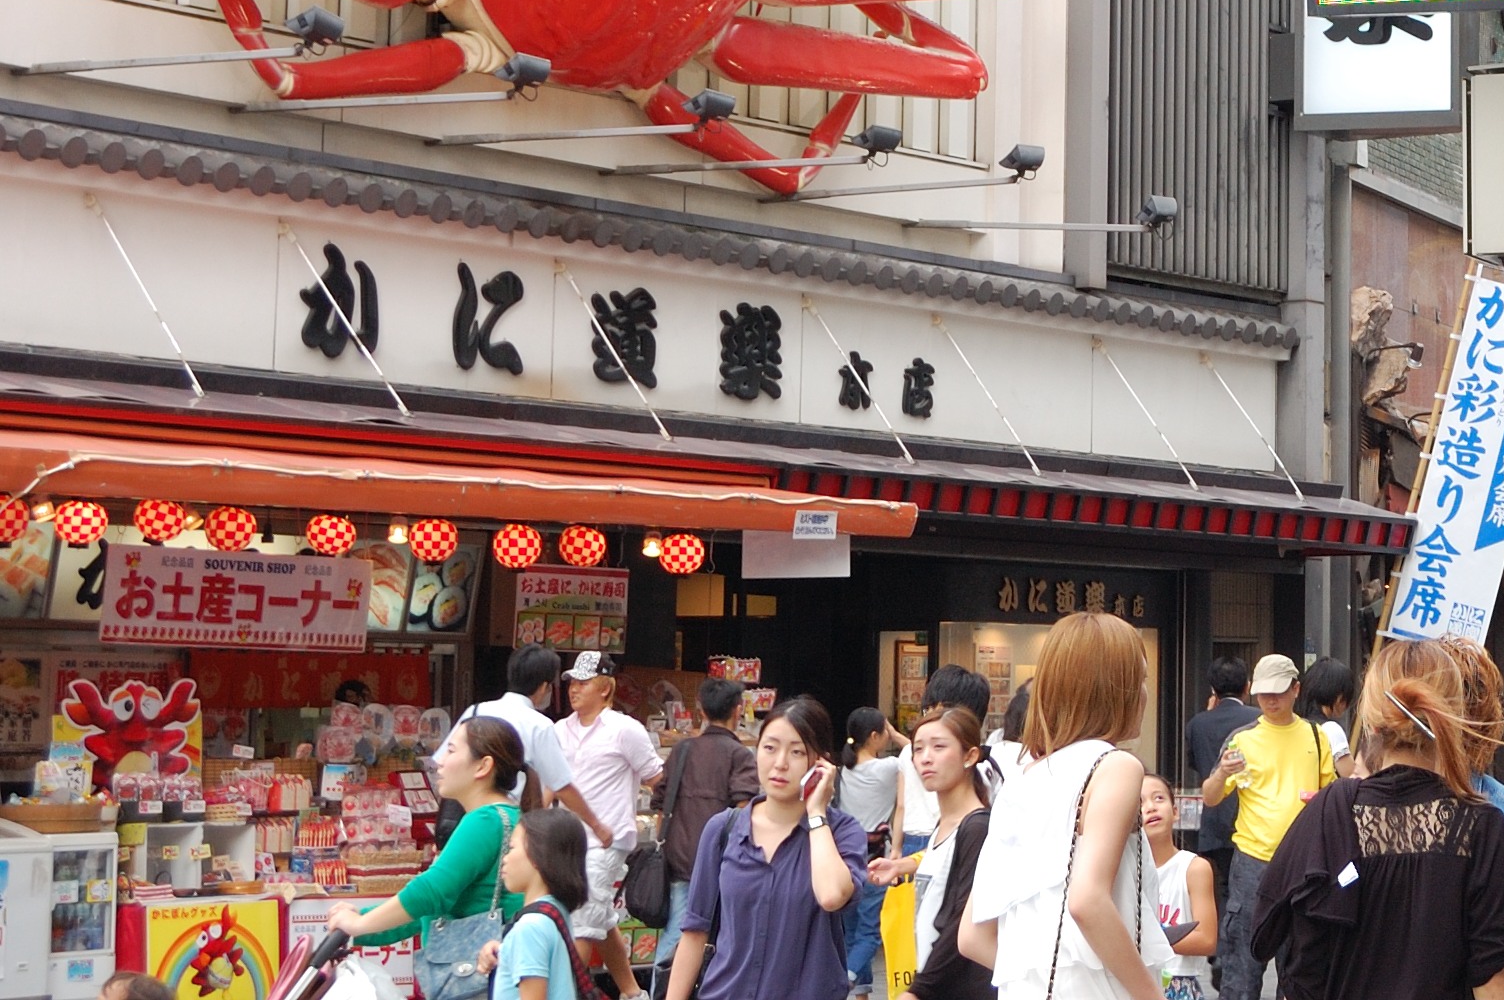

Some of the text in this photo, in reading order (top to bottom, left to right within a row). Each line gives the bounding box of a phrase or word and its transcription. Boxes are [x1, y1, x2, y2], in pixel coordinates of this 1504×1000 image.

[1395, 285, 1504, 629] かに彩造り会席
[204, 558, 264, 573] SOUVENIR
[266, 561, 297, 575] SHOP
[116, 569, 360, 627] お土産コーナー
